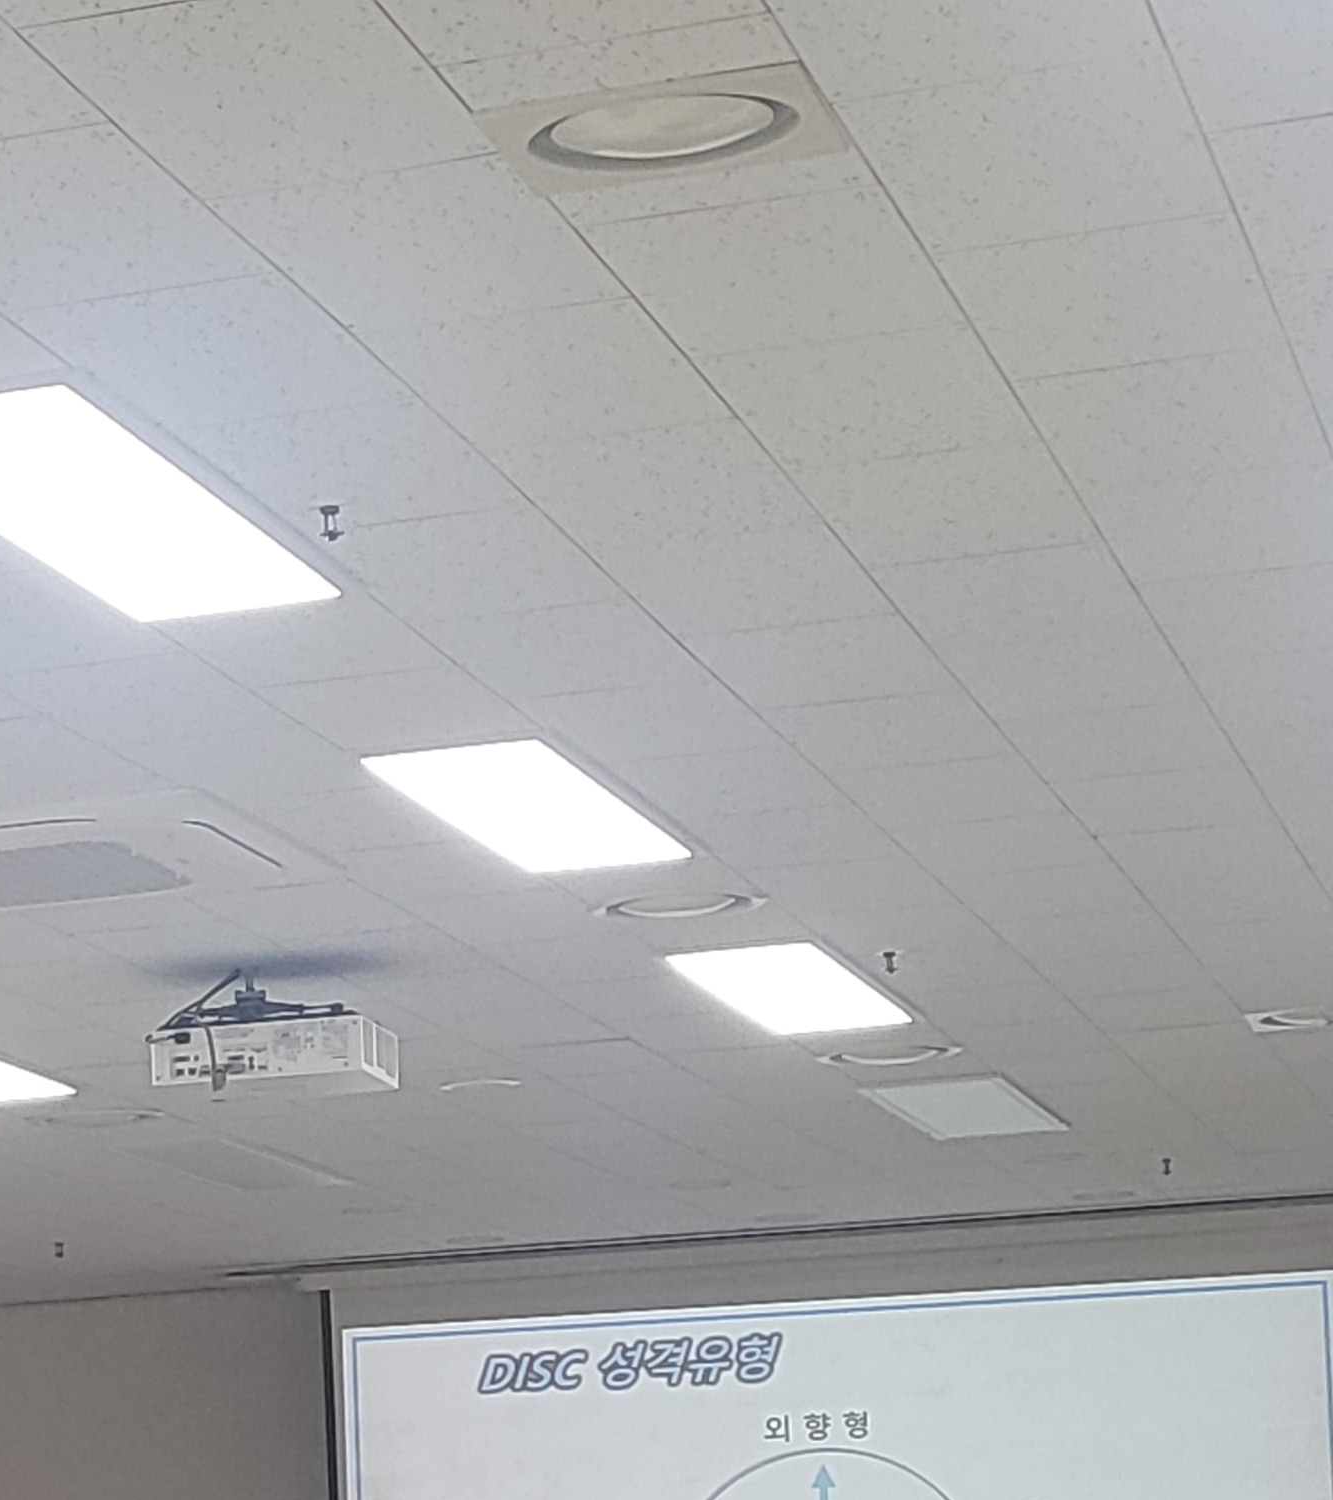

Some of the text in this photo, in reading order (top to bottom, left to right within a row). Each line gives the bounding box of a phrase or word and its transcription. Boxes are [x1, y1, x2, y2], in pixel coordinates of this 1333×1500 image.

[478, 1331, 783, 1394] DISC 성격유형
[764, 1410, 870, 1442] 외향형
